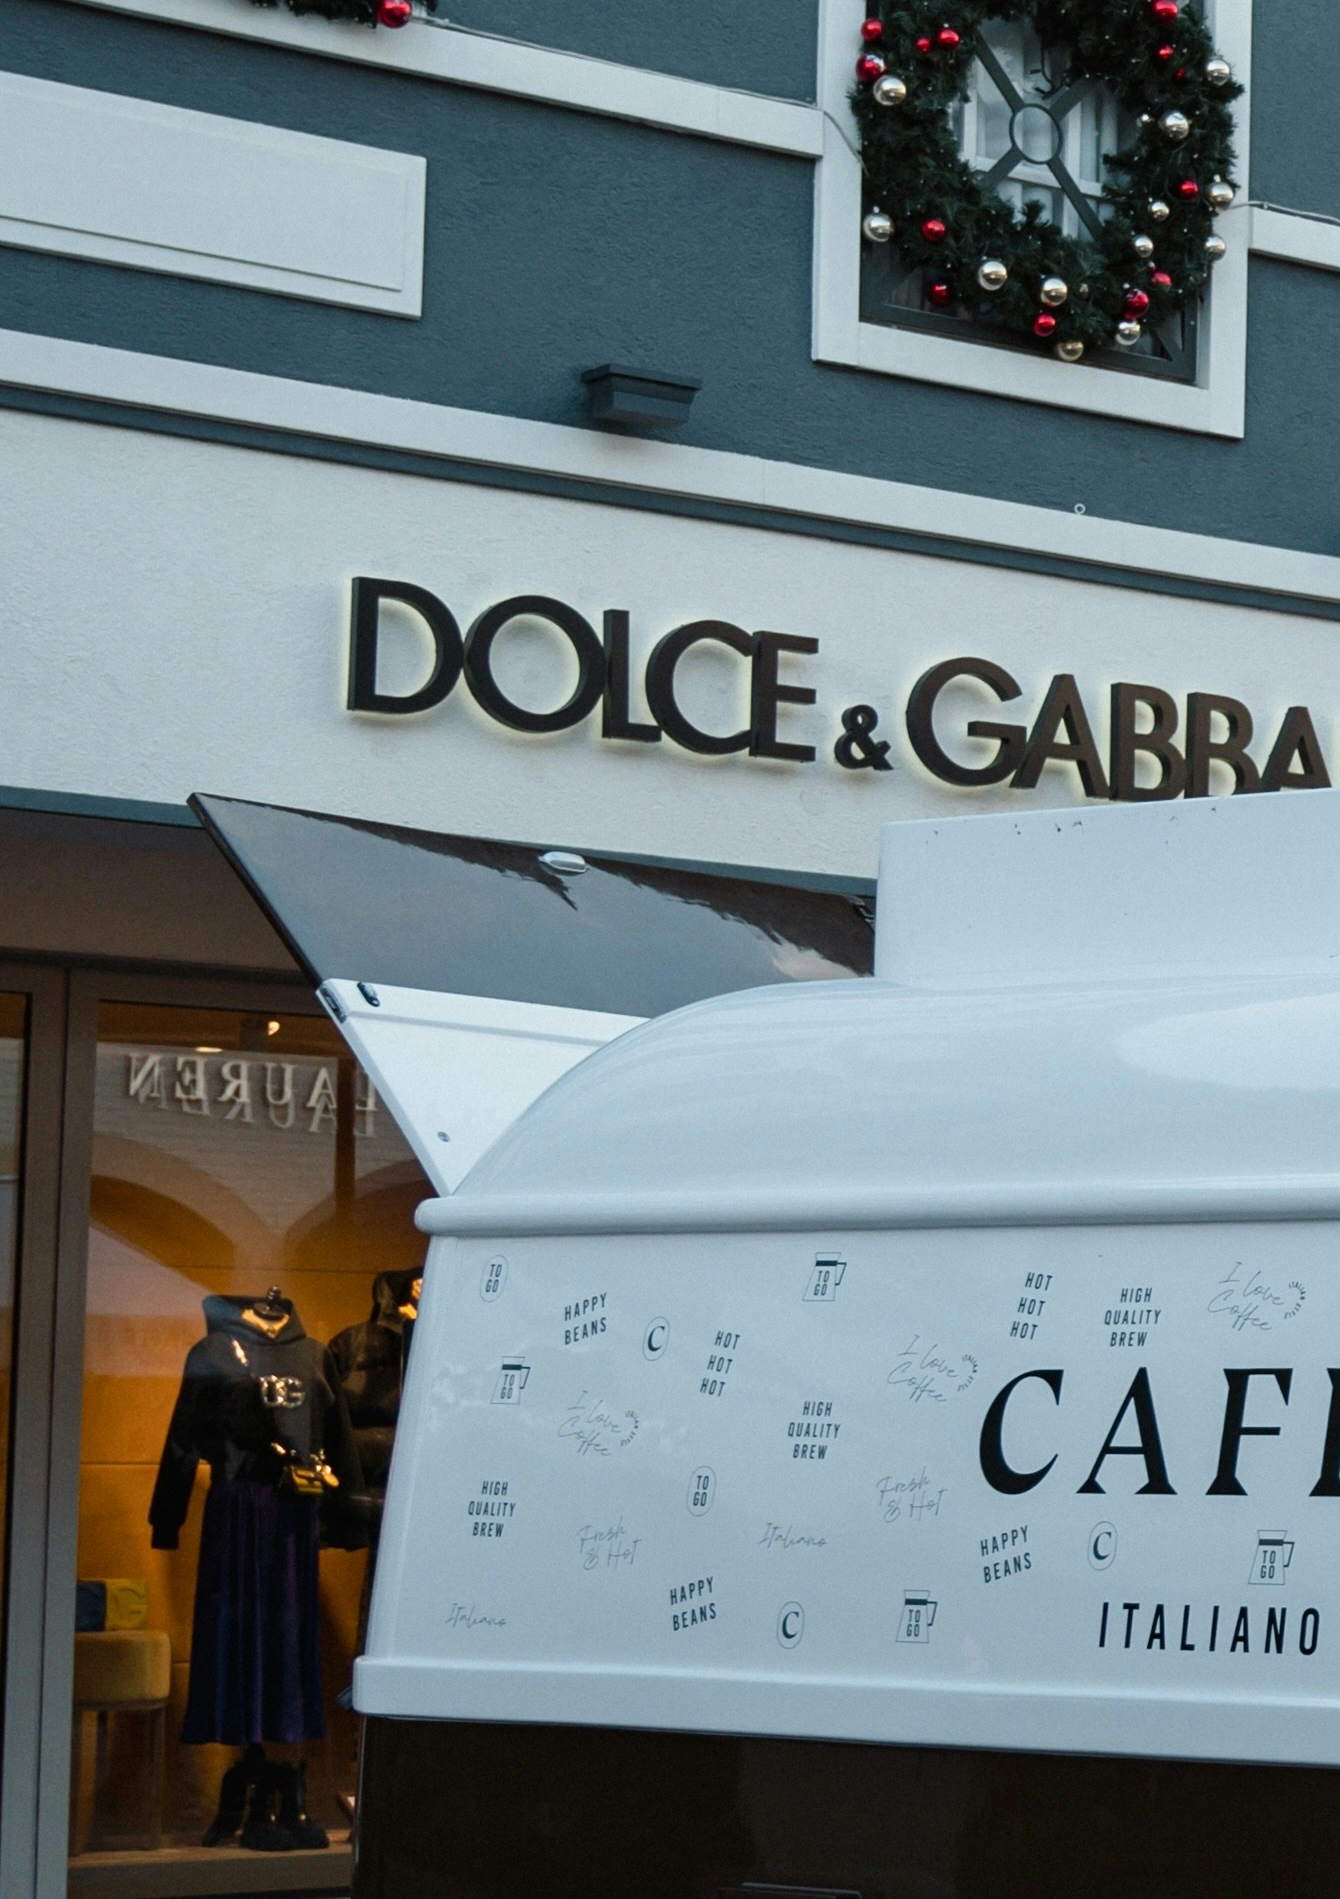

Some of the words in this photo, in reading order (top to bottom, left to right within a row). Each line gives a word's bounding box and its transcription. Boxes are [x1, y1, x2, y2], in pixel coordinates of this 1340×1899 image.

[348, 576, 820, 766] DOLCE
[834, 704, 893, 772] &
[489, 1263, 503, 1278] TO
[817, 1270, 830, 1283] TO
[484, 1278, 500, 1293] GO
[813, 1284, 827, 1296] GO
[1024, 1271, 1054, 1291] HOT
[1219, 1261, 1242, 1284] I
[1243, 1271, 1284, 1305] love
[1119, 1287, 1153, 1304] HIGH
[564, 1292, 607, 1321] HAPPY
[1017, 1296, 1046, 1317] HOT
[1208, 1289, 1272, 1331] Coffee
[1103, 1309, 1162, 1326] QUALITY
[564, 1317, 607, 1346] BEANS
[647, 1325, 666, 1353] C
[714, 1330, 741, 1350] HOT
[1009, 1320, 1039, 1341] HOT
[1109, 1331, 1148, 1348] BREW
[706, 1354, 734, 1375] HOT
[503, 1374, 515, 1386] TO
[699, 1377, 726, 1397] HOT
[501, 1387, 513, 1399] GO
[802, 1400, 833, 1417] HIGH
[787, 1421, 841, 1439] QUALITY
[792, 1443, 828, 1460] BREW
[481, 1480, 509, 1496] HIGH
[696, 1474, 710, 1491] TO
[876, 1466, 930, 1505] Fresh
[467, 1500, 516, 1518] QUALITY
[692, 1491, 708, 1507] GO
[909, 1489, 948, 1521] Hot
[472, 1521, 505, 1538] BREW
[577, 1516, 626, 1553] Fresh
[759, 1522, 828, 1549] Italiano
[980, 1525, 1029, 1557] HAPPY
[1092, 1531, 1112, 1561] C
[608, 1539, 642, 1570] Hot
[1262, 1550, 1276, 1565] TO
[983, 1552, 1033, 1583] BEANS
[1259, 1564, 1276, 1580] GO
[669, 1576, 714, 1606] HAPPY
[445, 1602, 507, 1628] Italiano
[672, 1602, 717, 1631] BEANS
[908, 1608, 921, 1624] TO
[781, 1611, 800, 1640] C
[906, 1623, 921, 1638] GO
[1097, 1601, 1321, 1657] ITALIANO
